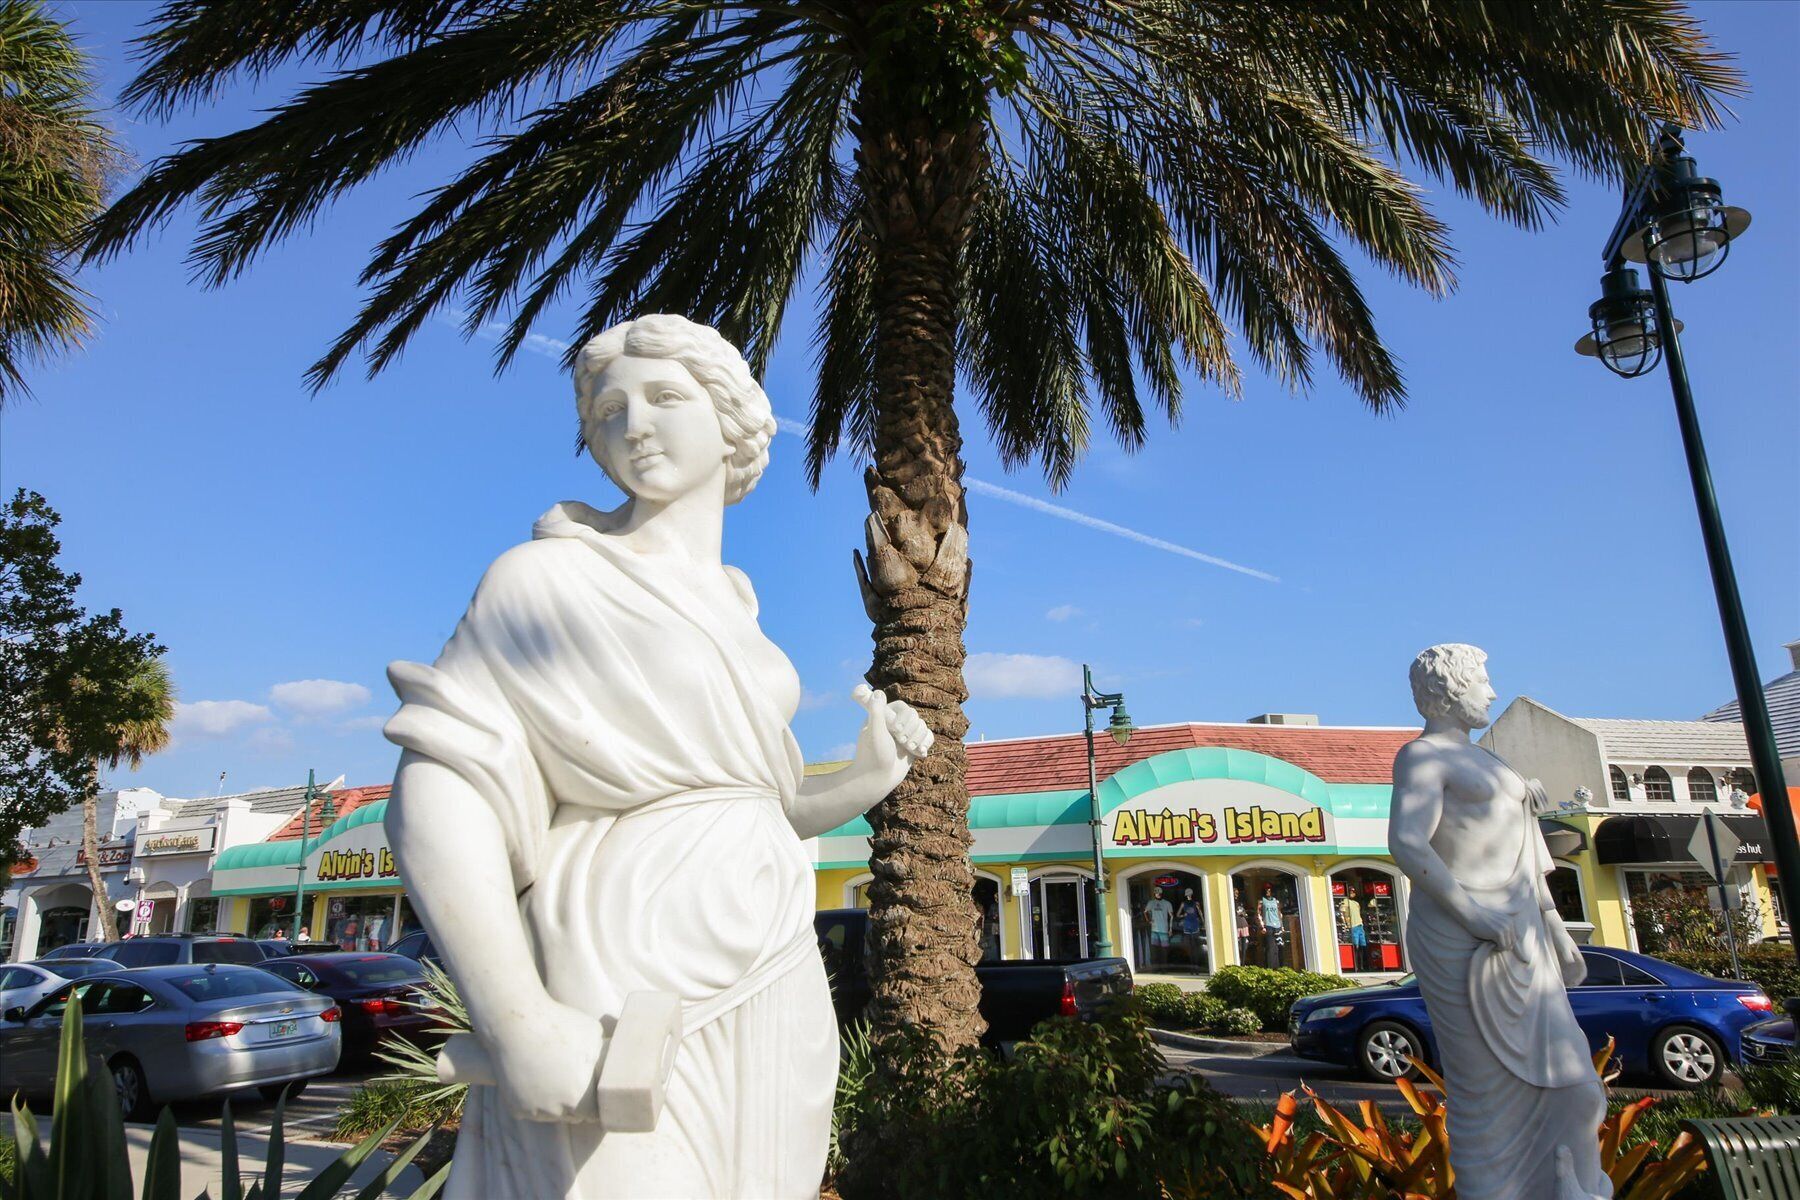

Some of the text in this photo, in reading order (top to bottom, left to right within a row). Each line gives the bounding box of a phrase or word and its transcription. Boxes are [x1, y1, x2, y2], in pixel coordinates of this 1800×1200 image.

[1112, 805, 1326, 846] Alvin's Island
[1747, 842, 1762, 854] hut
[317, 849, 375, 881] Alvin's
